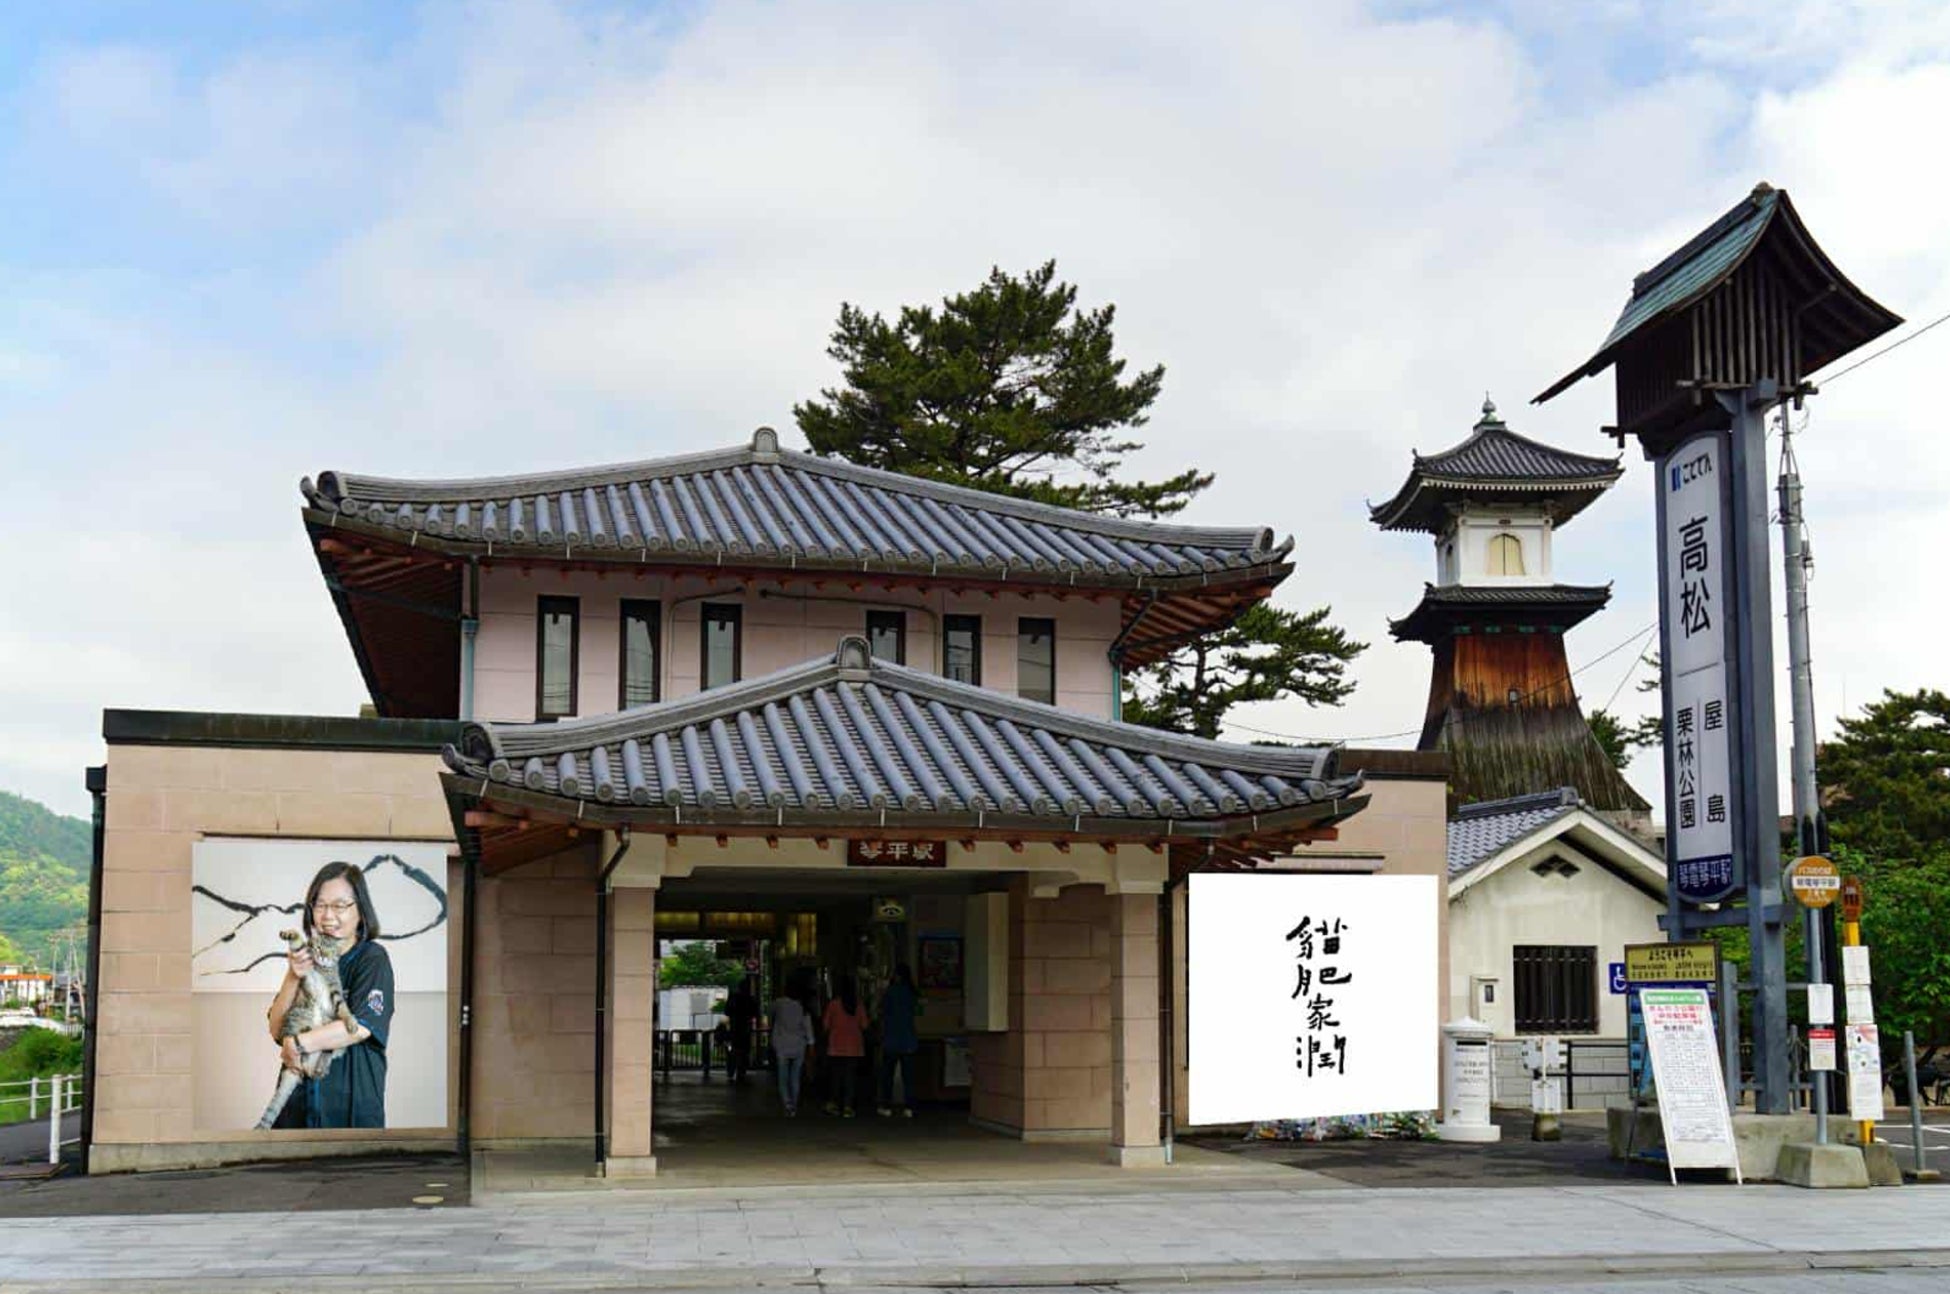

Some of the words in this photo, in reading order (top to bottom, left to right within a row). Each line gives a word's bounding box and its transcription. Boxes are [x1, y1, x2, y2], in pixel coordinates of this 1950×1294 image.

[1682, 452, 1713, 485] ことてん
[1678, 516, 1711, 639] 高松
[1676, 708, 1696, 830] 栗林公園
[1703, 700, 1726, 825] 屋島
[1285, 915, 1353, 1079] 貓肥家潤
